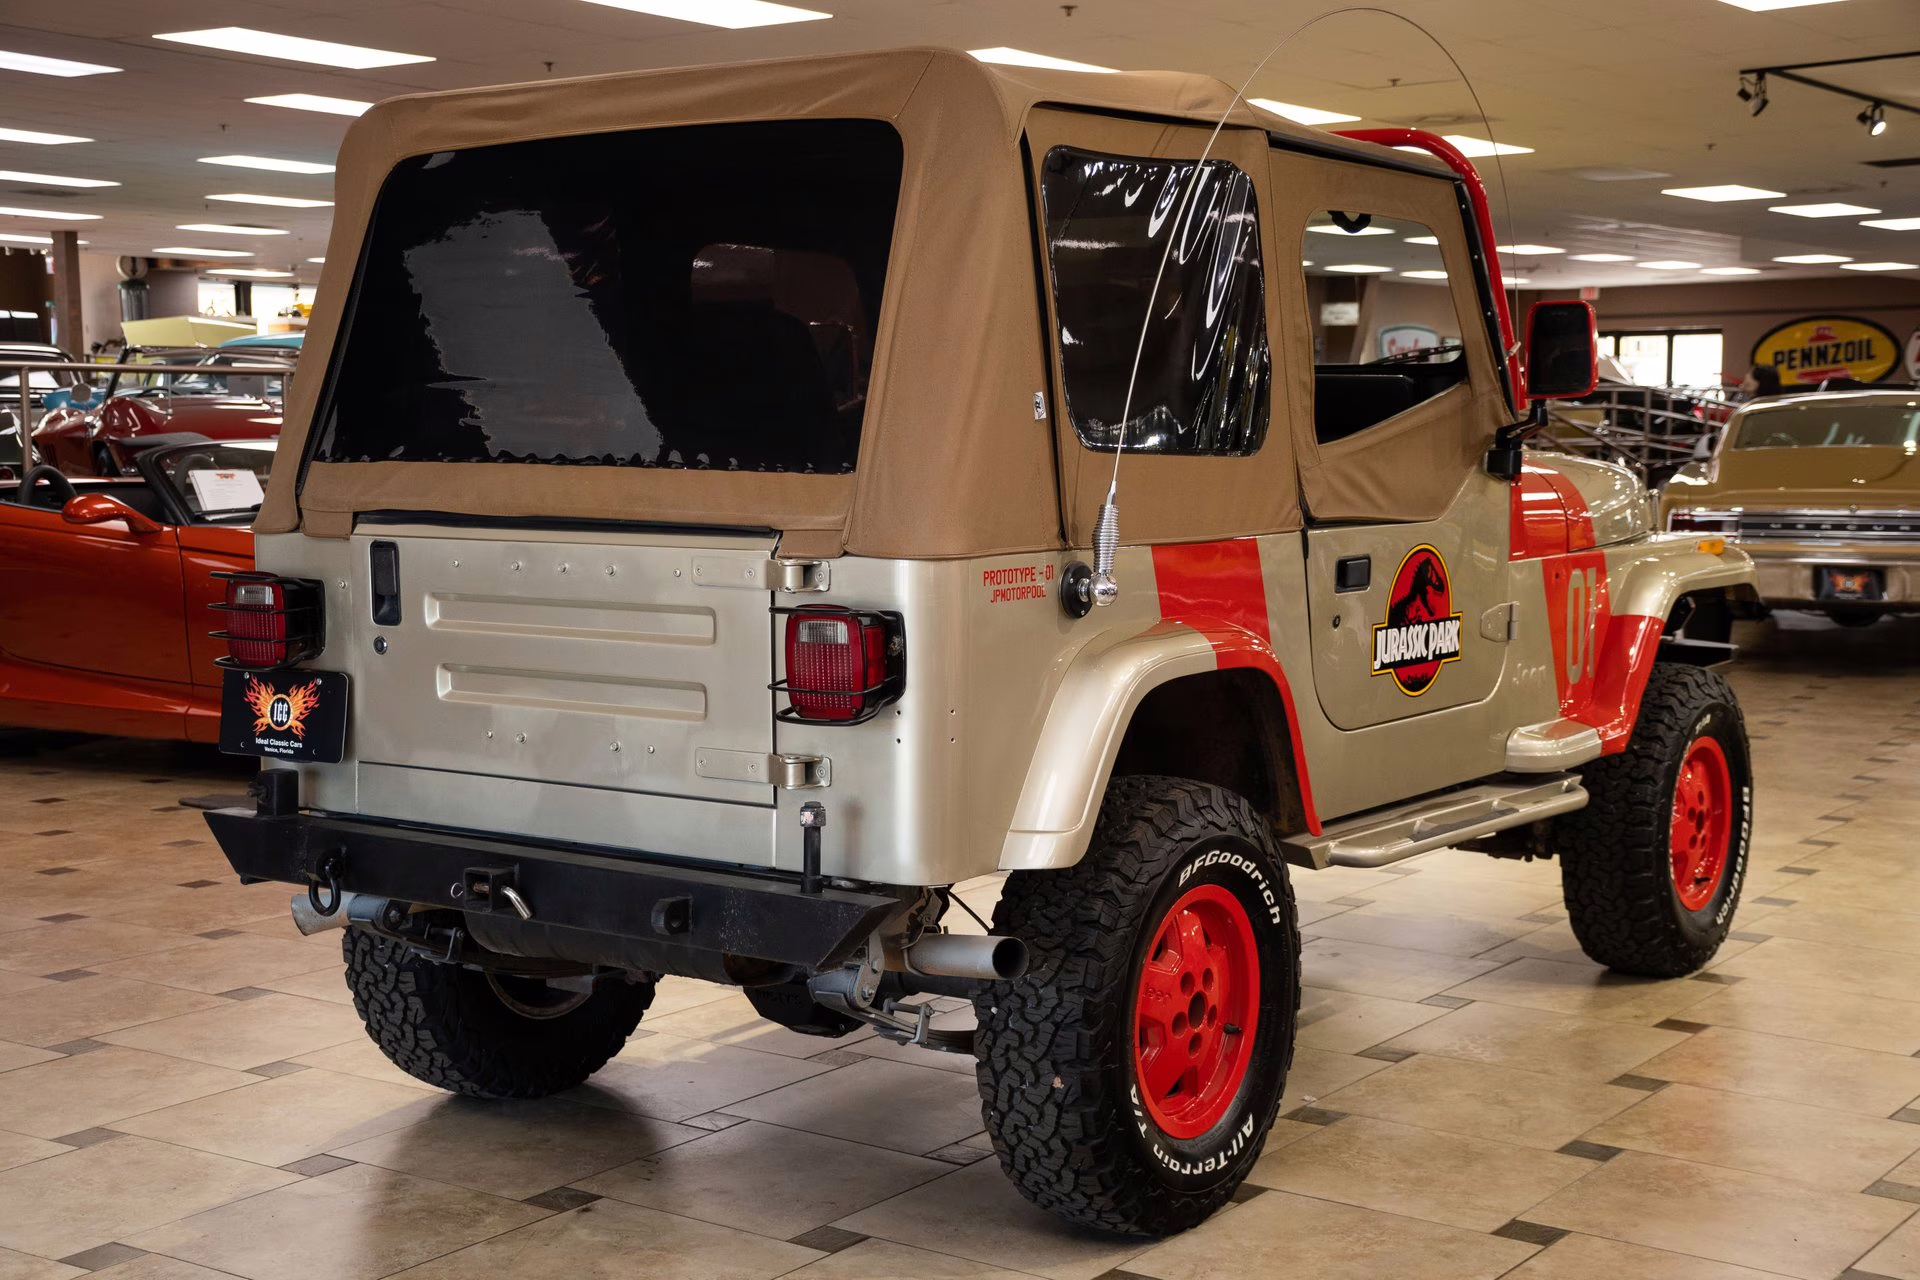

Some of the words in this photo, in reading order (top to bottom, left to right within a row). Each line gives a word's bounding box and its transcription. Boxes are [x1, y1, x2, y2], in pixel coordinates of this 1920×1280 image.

[1773, 338, 1877, 370] PENNZOIL
[983, 567, 1036, 586] PROTOTYPE
[1045, 565, 1054, 580] 01
[990, 585, 1046, 603] JPMOTORPOOL
[1374, 622, 1427, 670] JURASSIC
[1427, 620, 1460, 660] PARK
[1567, 567, 1597, 685] 01
[255, 737, 268, 745] Ideal
[270, 738, 288, 747] Classic
[290, 740, 302, 748] Cars
[1178, 850, 1281, 925] BFGoodrich
[1153, 1112, 1254, 1175] All-Terrain
